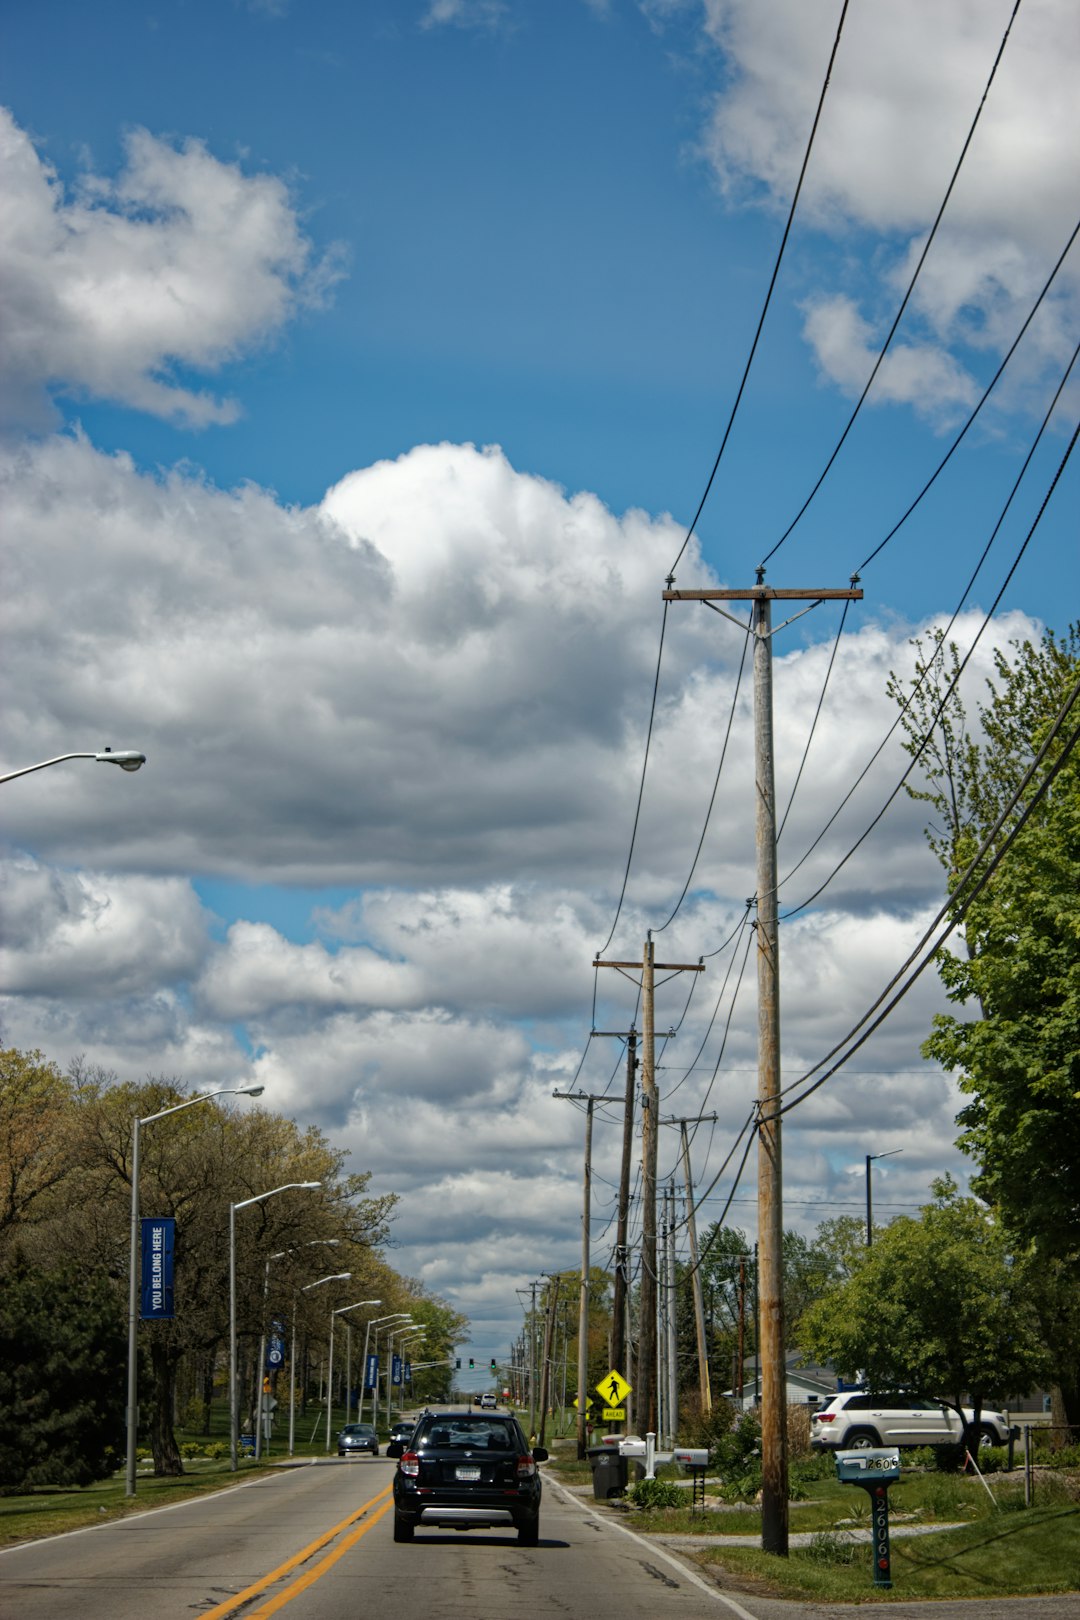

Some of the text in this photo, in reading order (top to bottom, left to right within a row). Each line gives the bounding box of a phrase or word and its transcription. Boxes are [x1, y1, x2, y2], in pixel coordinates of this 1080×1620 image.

[152, 1227, 162, 1310] YOU BELONG HERE
[868, 1456, 899, 1469] 2606
[876, 1499, 888, 1556] 2606
